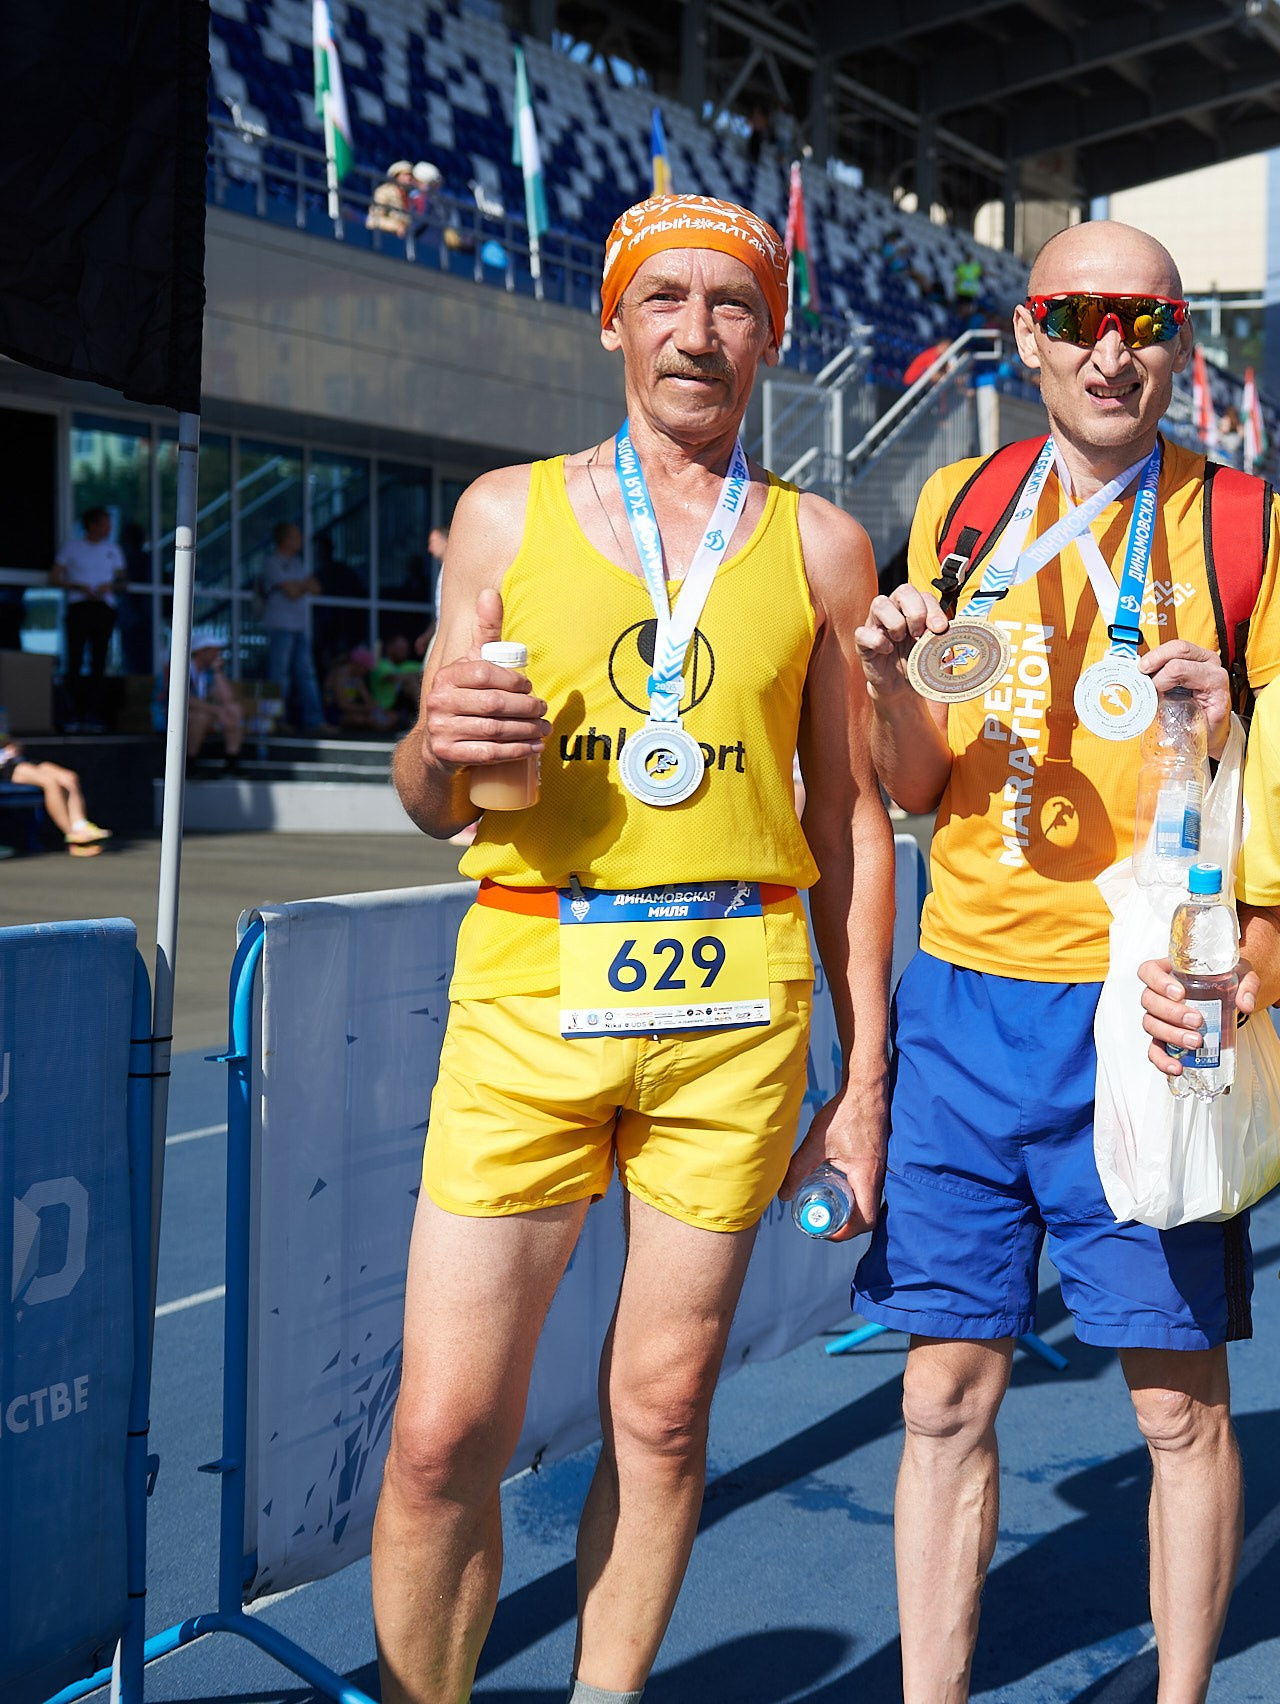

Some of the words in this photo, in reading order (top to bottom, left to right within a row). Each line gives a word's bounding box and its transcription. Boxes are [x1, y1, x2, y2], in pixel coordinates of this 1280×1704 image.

[617, 436, 638, 475] МИЛЯ
[722, 464, 747, 513] БЕЖИТ!
[1128, 490, 1157, 584] ДИНАМОВСКАЯ
[1139, 613, 1168, 626] 022
[559, 727, 746, 773] uhlort
[998, 623, 1055, 868] MARATHON
[613, 890, 716, 906] ДИНАМОВСКАЯ
[648, 905, 689, 918] МИЛЯ
[607, 936, 727, 993] 629
[4, 1374, 89, 1435] СТВЕ
